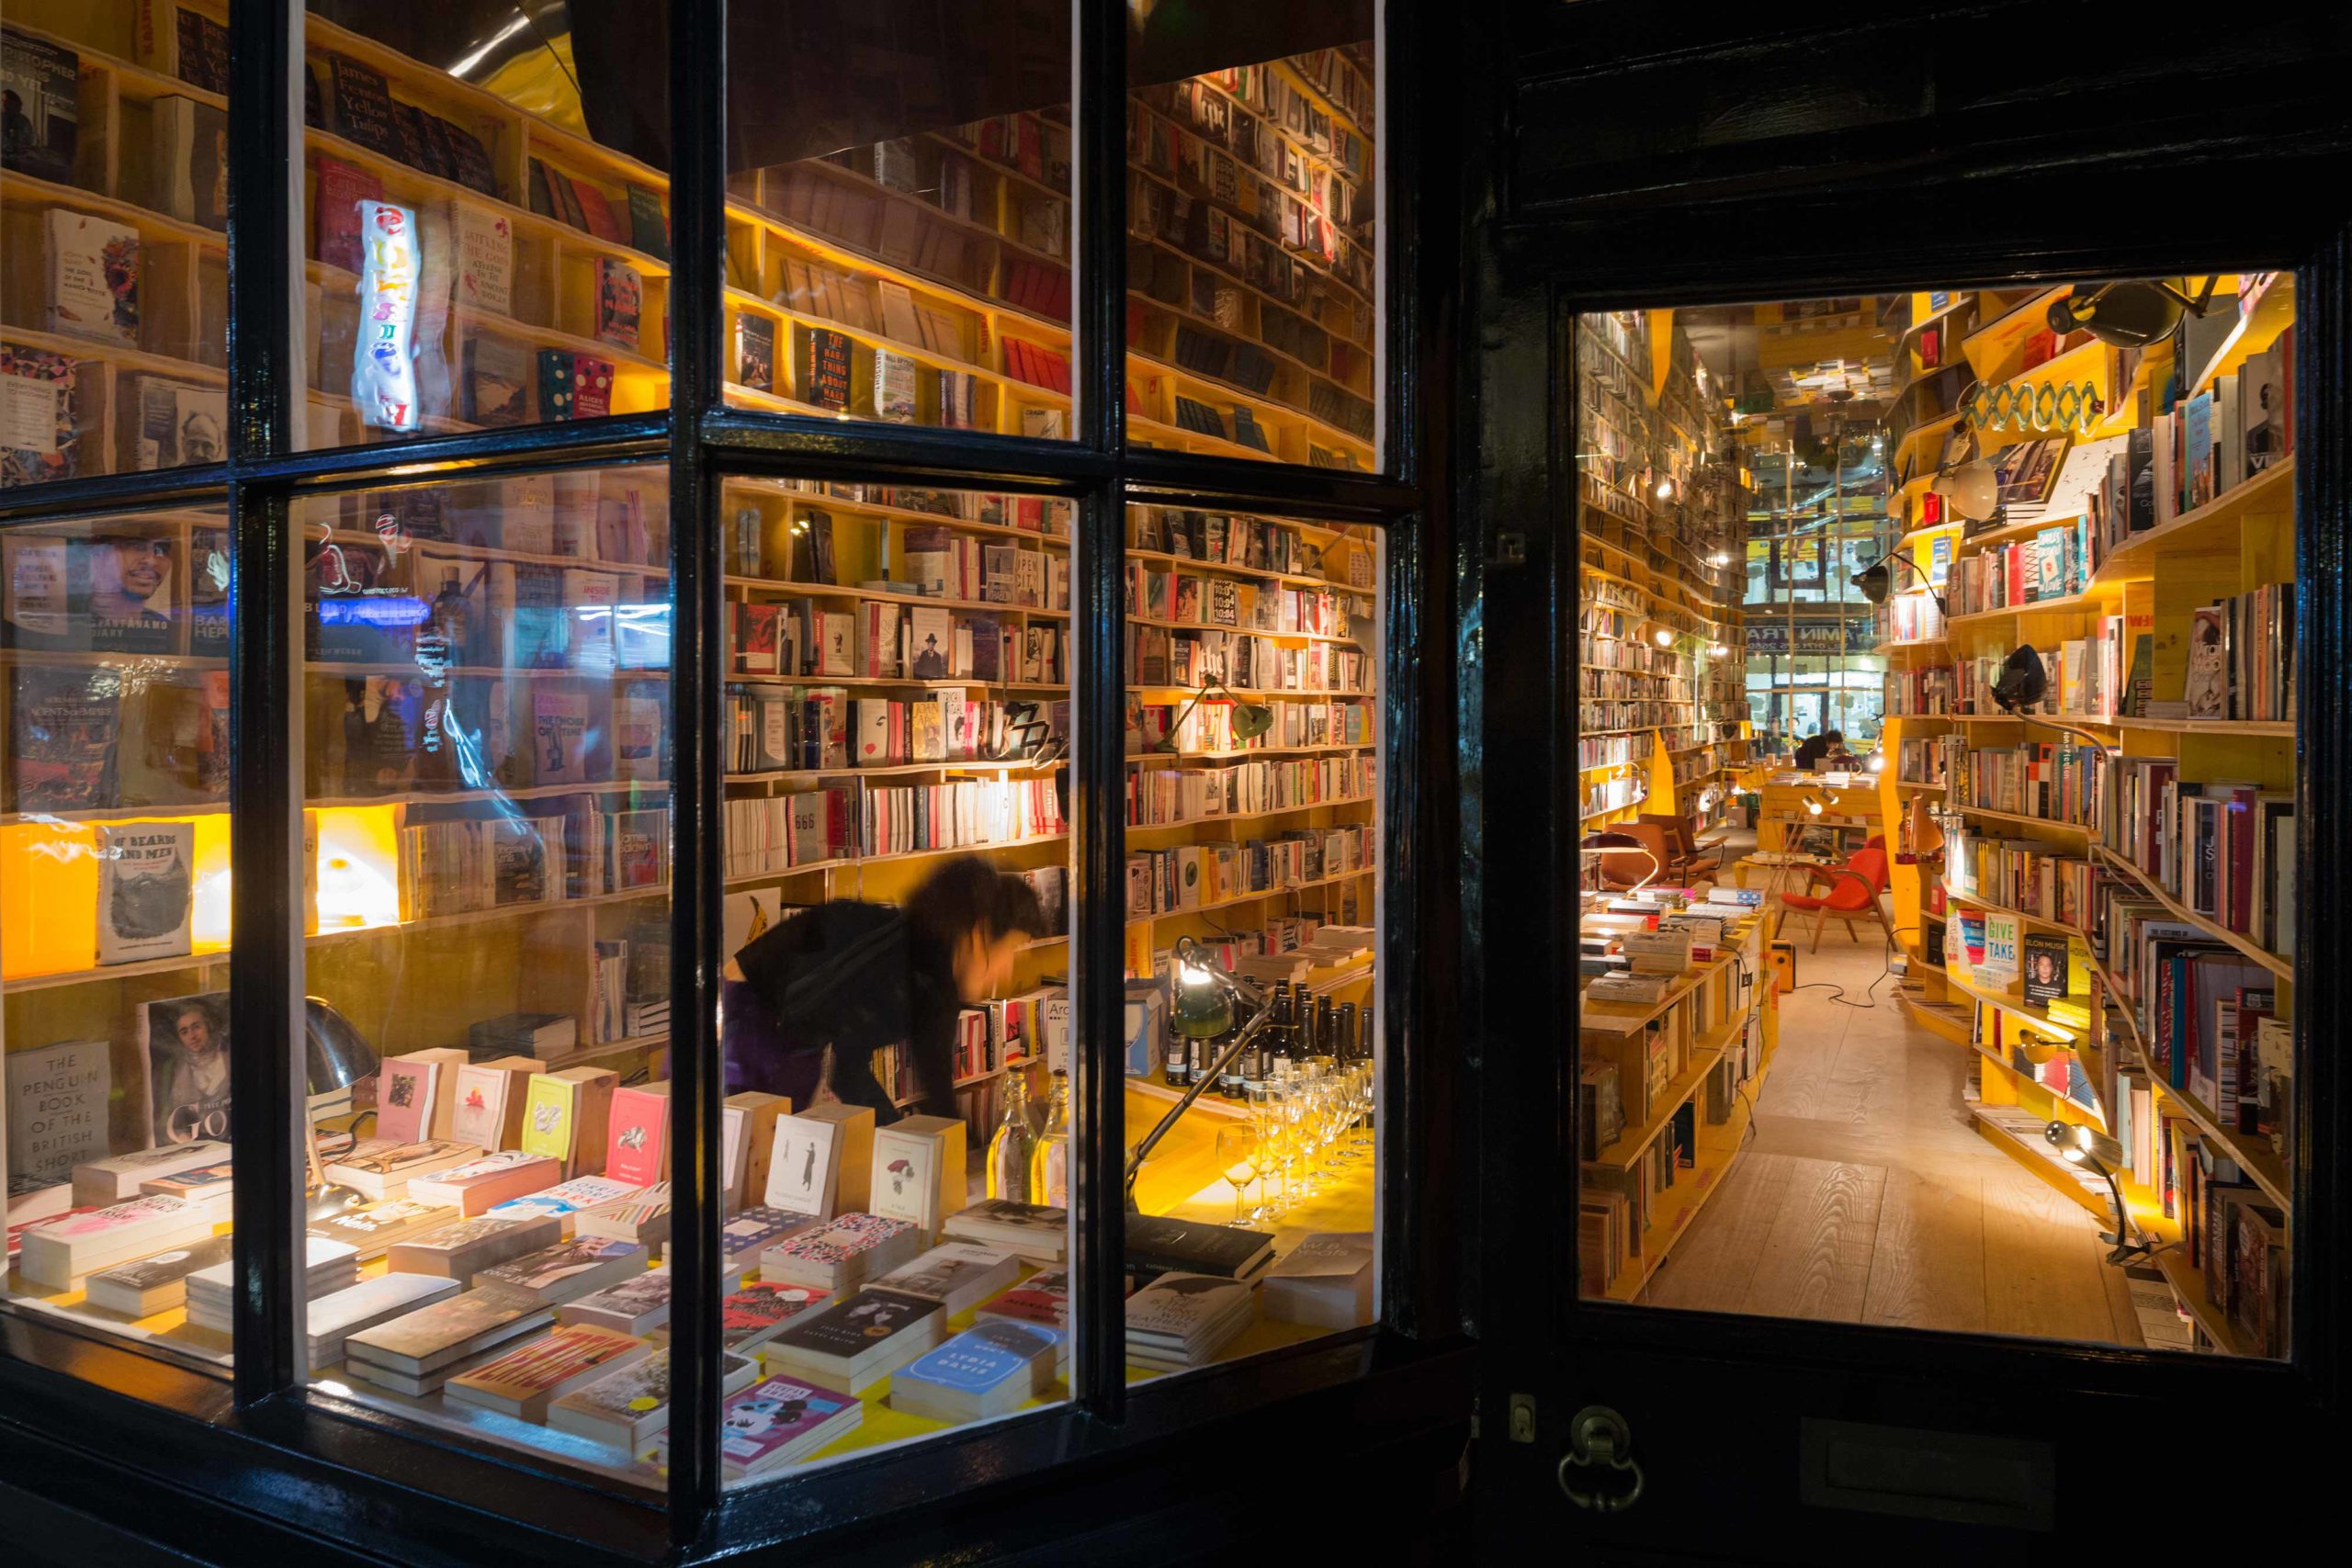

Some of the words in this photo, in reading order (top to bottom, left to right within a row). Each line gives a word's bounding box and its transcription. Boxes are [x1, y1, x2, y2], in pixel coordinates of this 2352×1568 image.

[341, 94, 389, 118] Yellow
[347, 112, 390, 140] Tulips
[829, 333, 844, 348] THE
[823, 348, 846, 363] HARD
[822, 360, 847, 377] THING
[821, 374, 848, 390] ABOUT
[823, 388, 845, 400] HARD
[583, 585, 611, 596] INSIDE
[1214, 608, 1235, 619] 10:04
[796, 813, 816, 830] 666
[129, 834, 176, 847] BEARDS
[146, 847, 173, 859] MEN
[1987, 921, 2014, 941] GIVE
[1988, 942, 2015, 961] TAKE
[2025, 938, 2043, 949] ELON
[2043, 940, 2066, 951] MUSK
[46, 1054, 77, 1072] THE
[22, 1072, 100, 1097] PENGUIN
[39, 1092, 85, 1112] BOOK
[30, 1118, 56, 1134] OF
[62, 1111, 93, 1129] THE
[32, 1130, 93, 1154] BRITISH
[36, 1150, 88, 1172] SHORT
[937, 1357, 989, 1376] DAVIS
[948, 1351, 997, 1370] LYDIA
